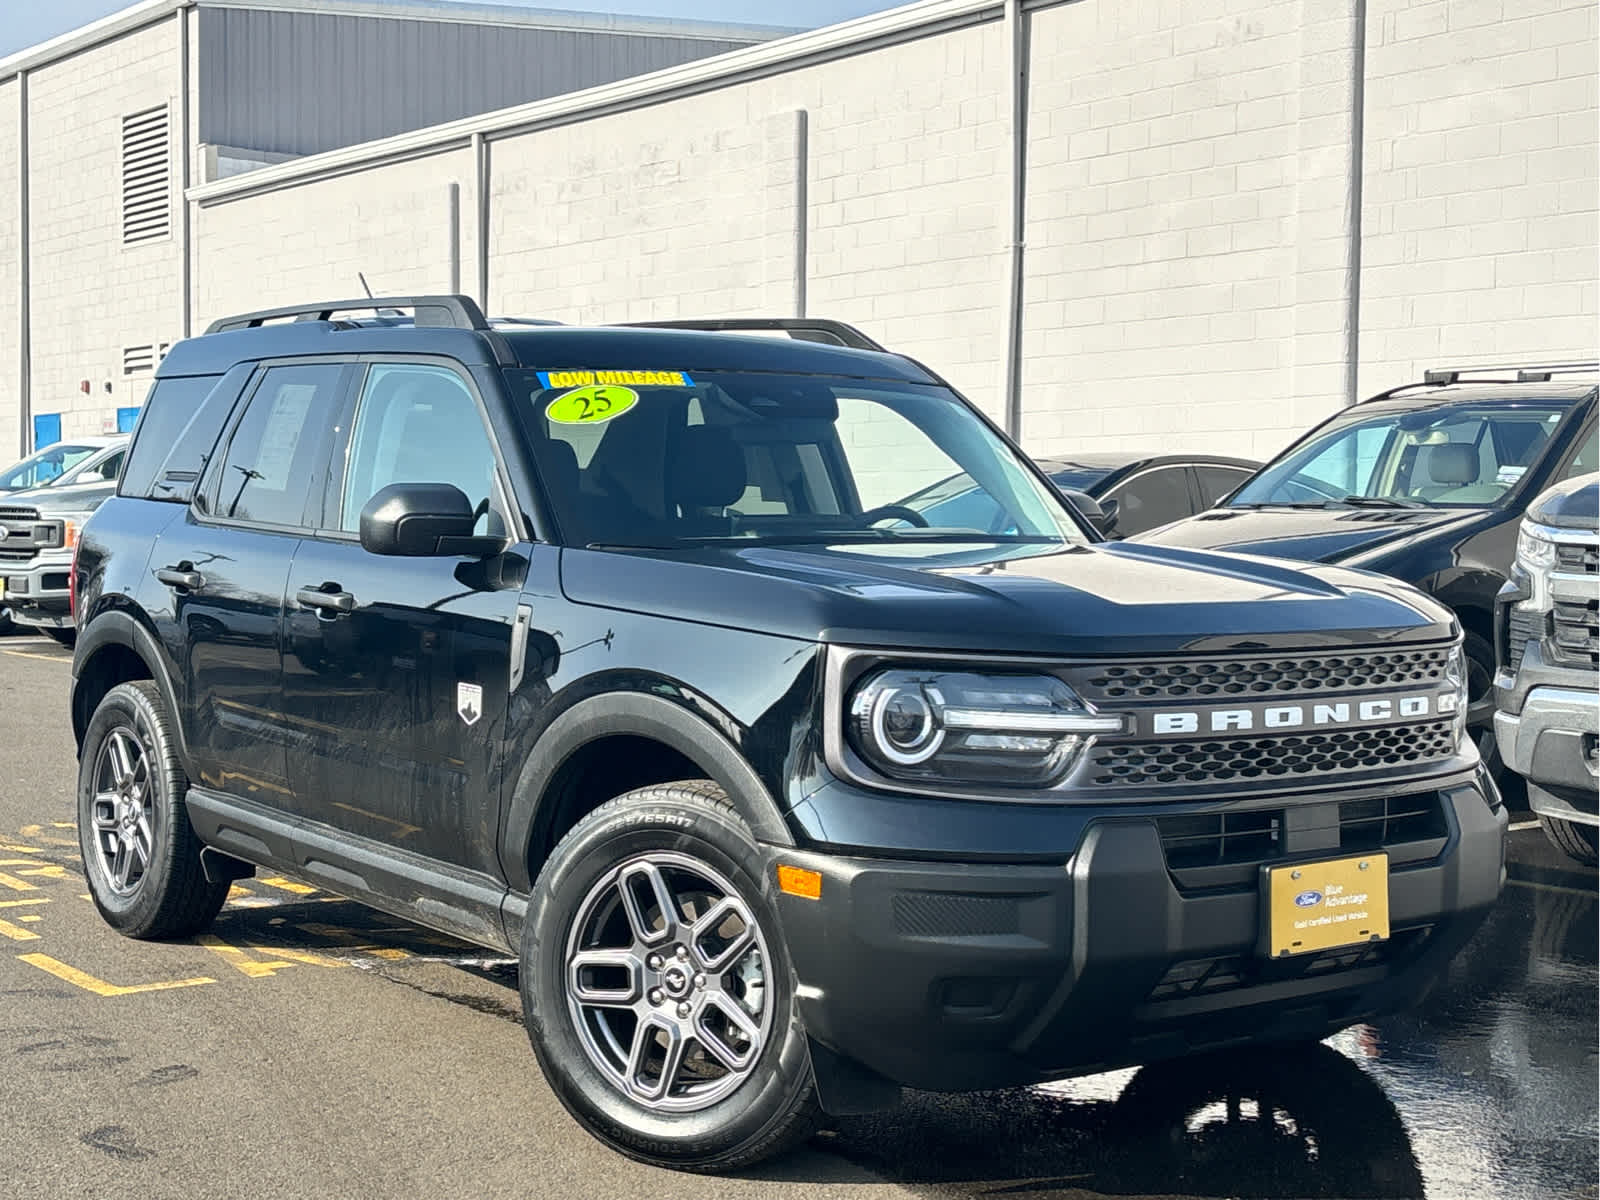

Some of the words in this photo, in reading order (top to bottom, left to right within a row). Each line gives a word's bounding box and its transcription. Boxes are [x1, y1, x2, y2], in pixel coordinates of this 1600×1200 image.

[548, 372, 594, 388] LOW
[596, 371, 686, 386] MILEAGE
[574, 389, 612, 419] 25
[1153, 696, 1429, 735] BRONCO
[1325, 885, 1343, 896] Blue
[1297, 892, 1320, 906] Ford
[1325, 894, 1368, 908] Advantage
